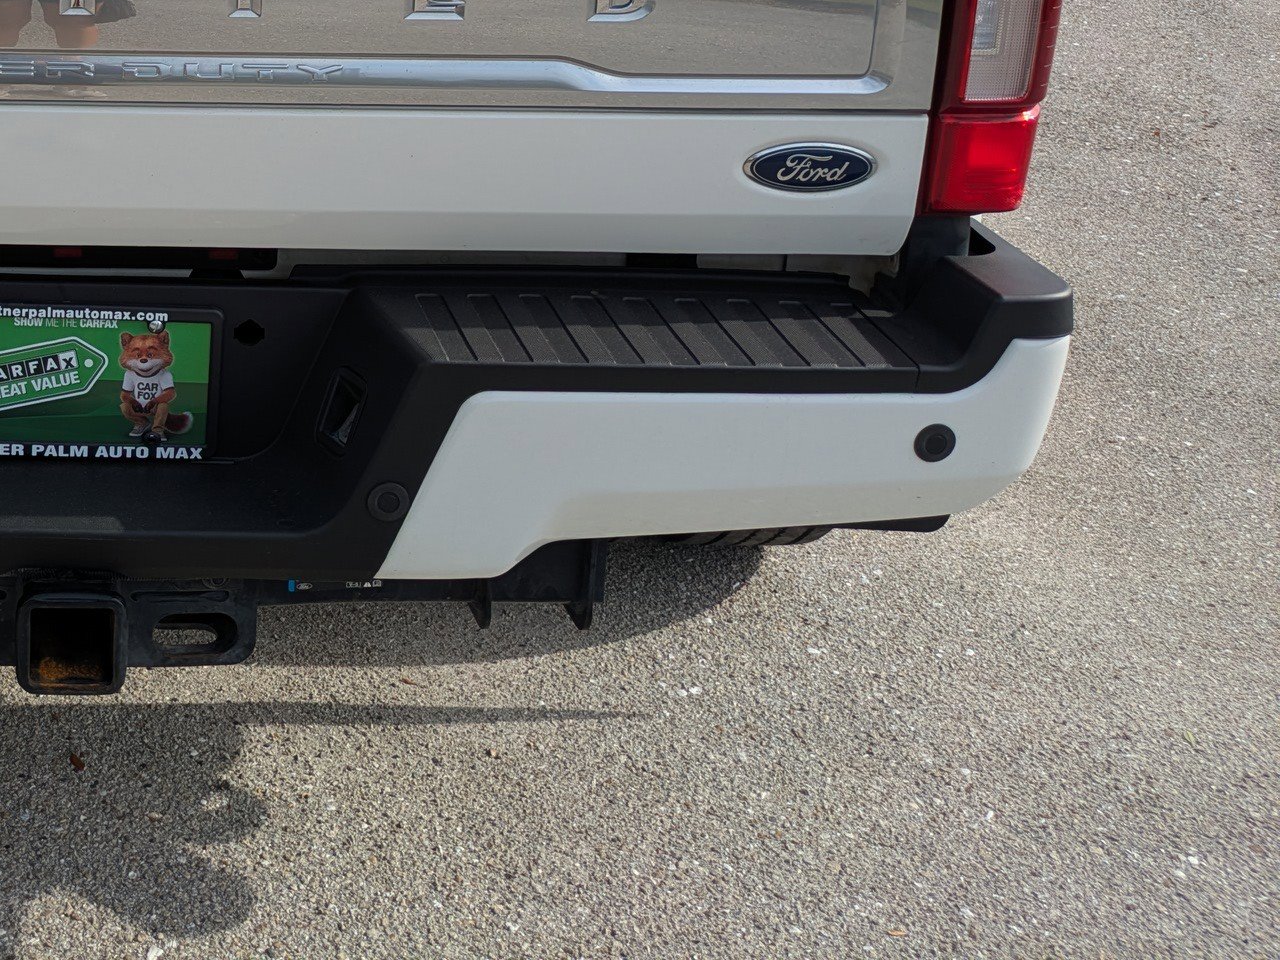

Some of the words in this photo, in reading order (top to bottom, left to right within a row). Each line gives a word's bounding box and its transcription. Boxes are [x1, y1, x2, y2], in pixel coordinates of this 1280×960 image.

[122, 60, 344, 83] DUTY
[776, 153, 850, 182] Ford
[13, 317, 43, 327] SHOW
[45, 318, 59, 328] ME
[62, 318, 78, 328] THE
[79, 318, 119, 329] CARFAX
[31, 371, 80, 392] VALUE
[137, 381, 159, 392] CAR
[137, 391, 157, 401] FOX
[31, 444, 88, 458] PALM
[95, 446, 149, 459] AUTO
[156, 447, 203, 460] MAX
